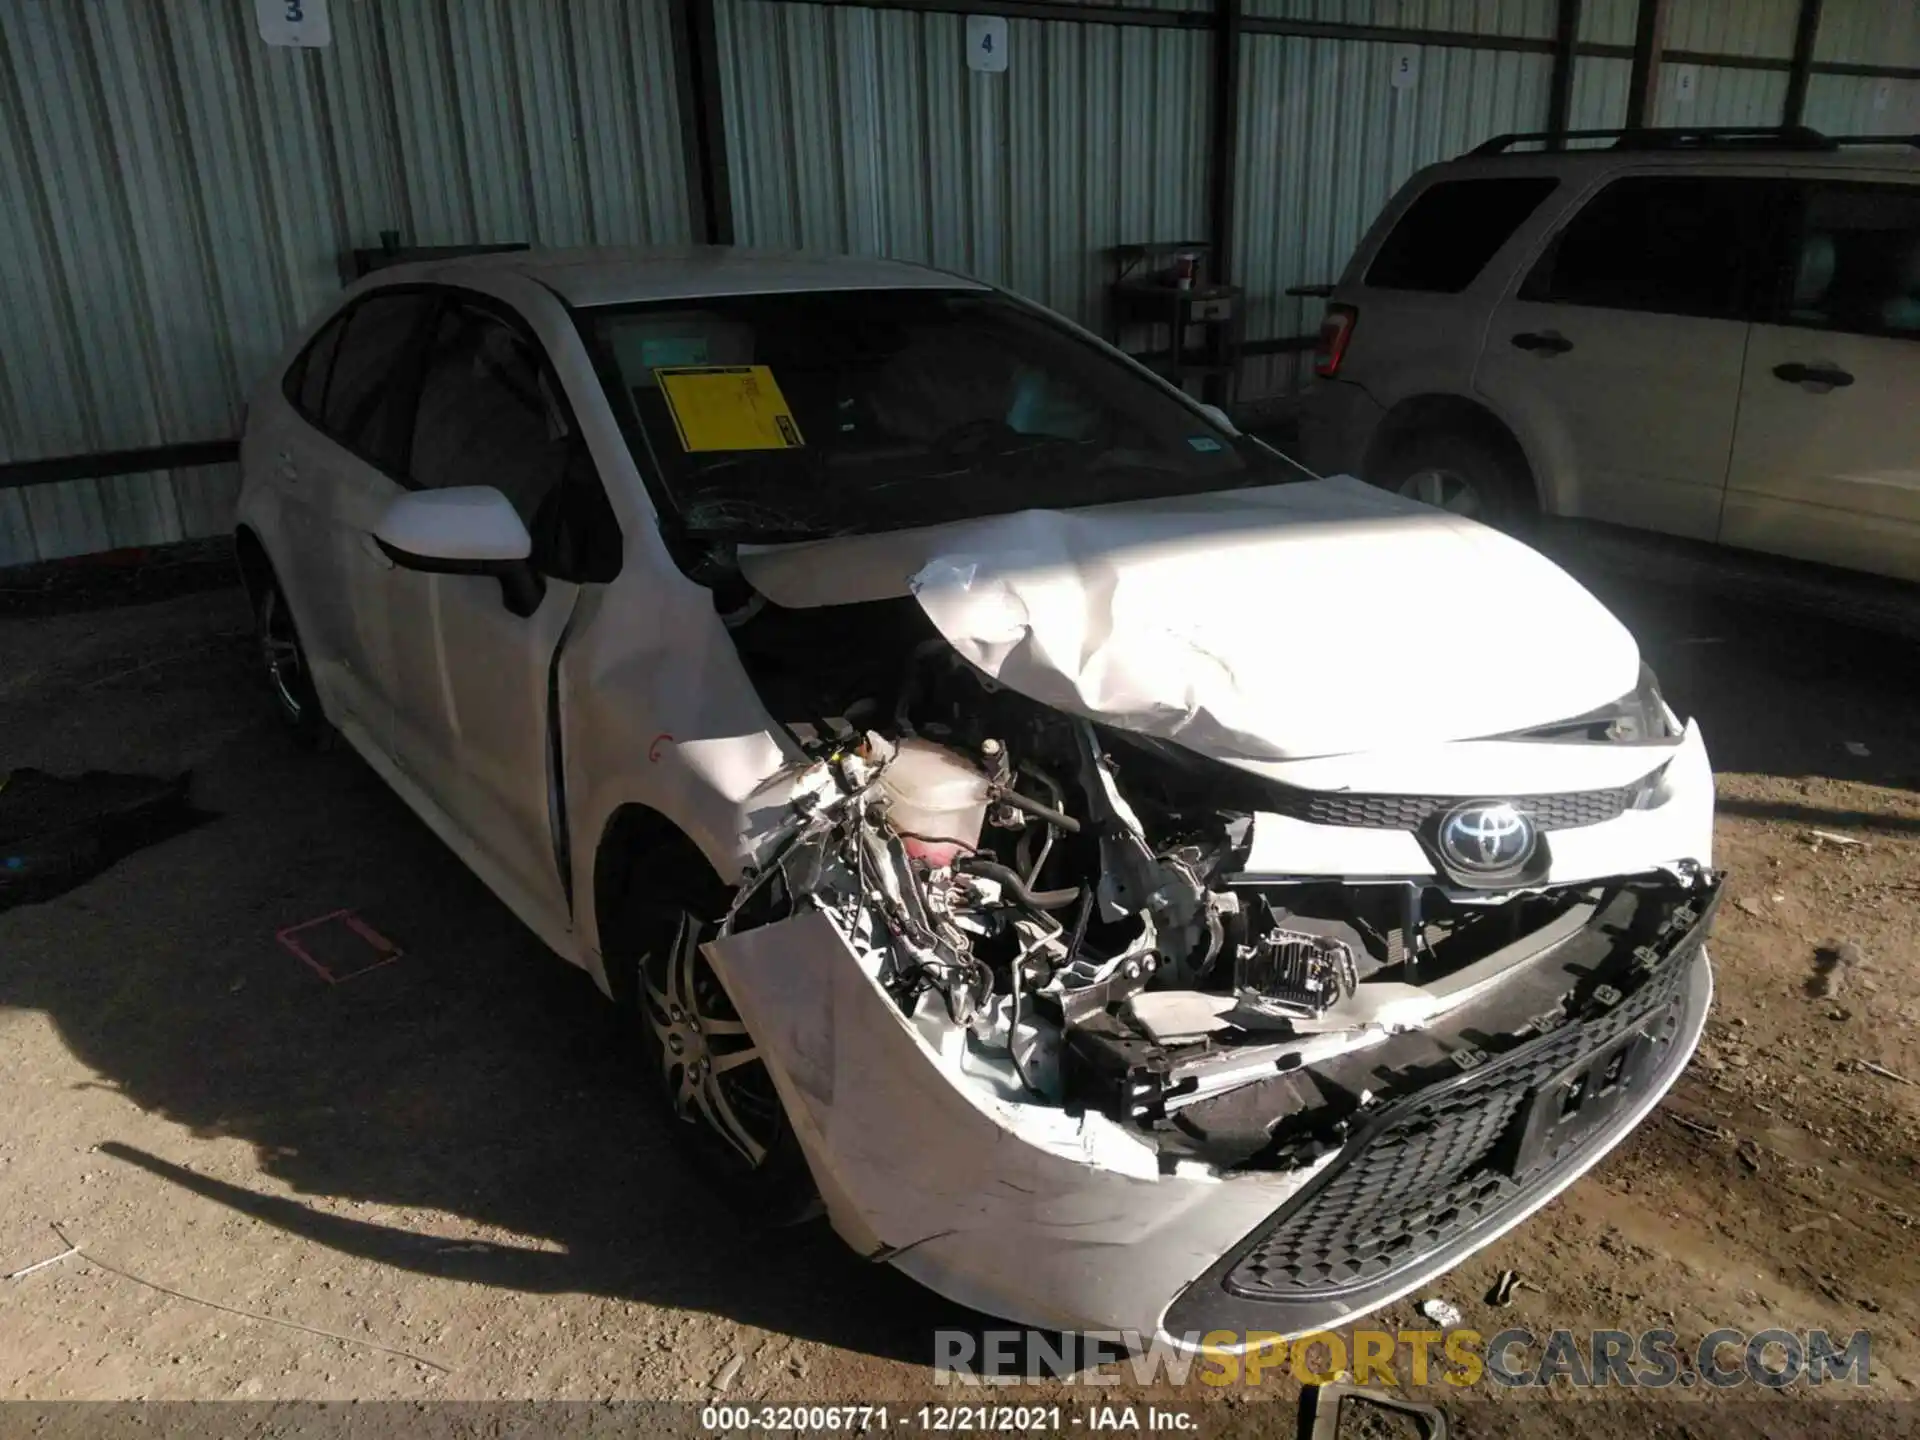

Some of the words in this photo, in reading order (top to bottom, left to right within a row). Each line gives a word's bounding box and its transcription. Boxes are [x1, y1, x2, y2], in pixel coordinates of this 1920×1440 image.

[284, 0, 303, 22] 3
[982, 33, 993, 54] 4
[1400, 57, 1409, 73] 5
